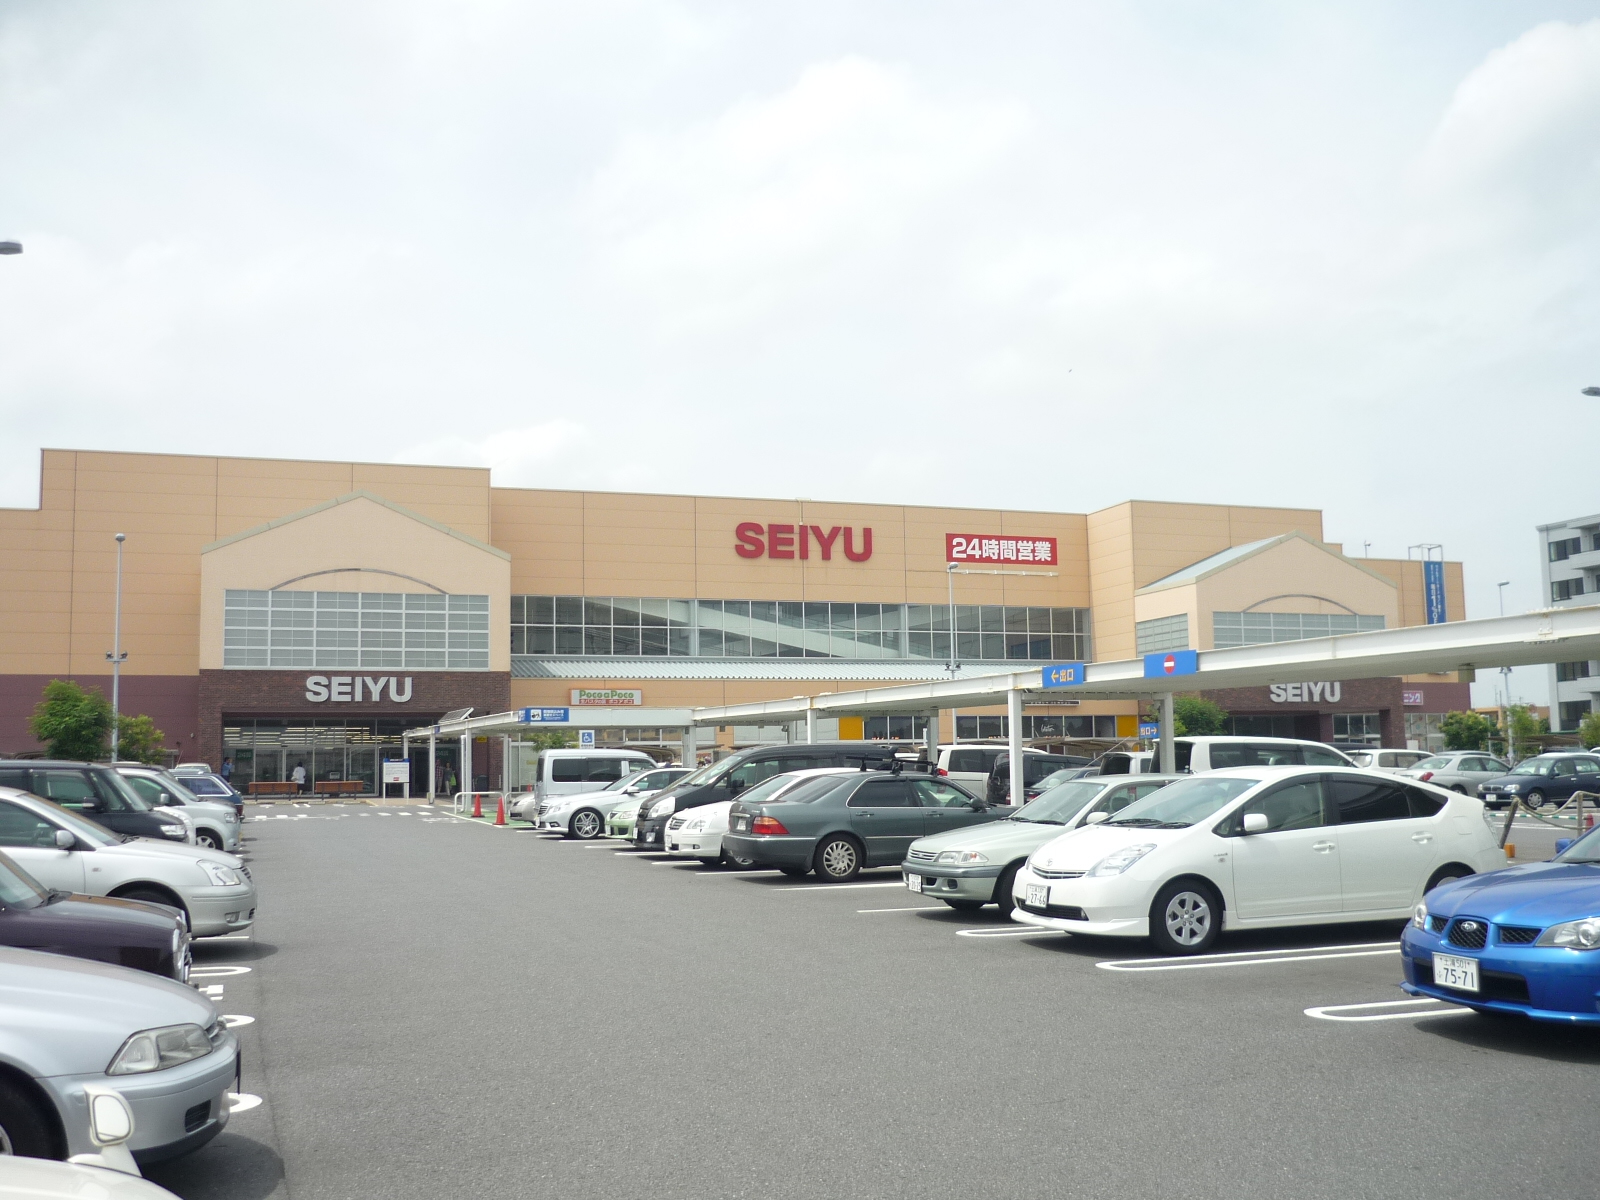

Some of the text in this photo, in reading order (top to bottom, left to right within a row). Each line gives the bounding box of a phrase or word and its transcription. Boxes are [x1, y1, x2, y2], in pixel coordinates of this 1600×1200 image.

[735, 522, 872, 562] SEIYU
[952, 537, 1051, 561] 24時間営業
[1060, 669, 1074, 682] 出口
[305, 675, 413, 703] SEIYU
[1270, 681, 1341, 703] SEIYU
[1140, 727, 1151, 736] 出口
[1443, 967, 1474, 988] 75-71
